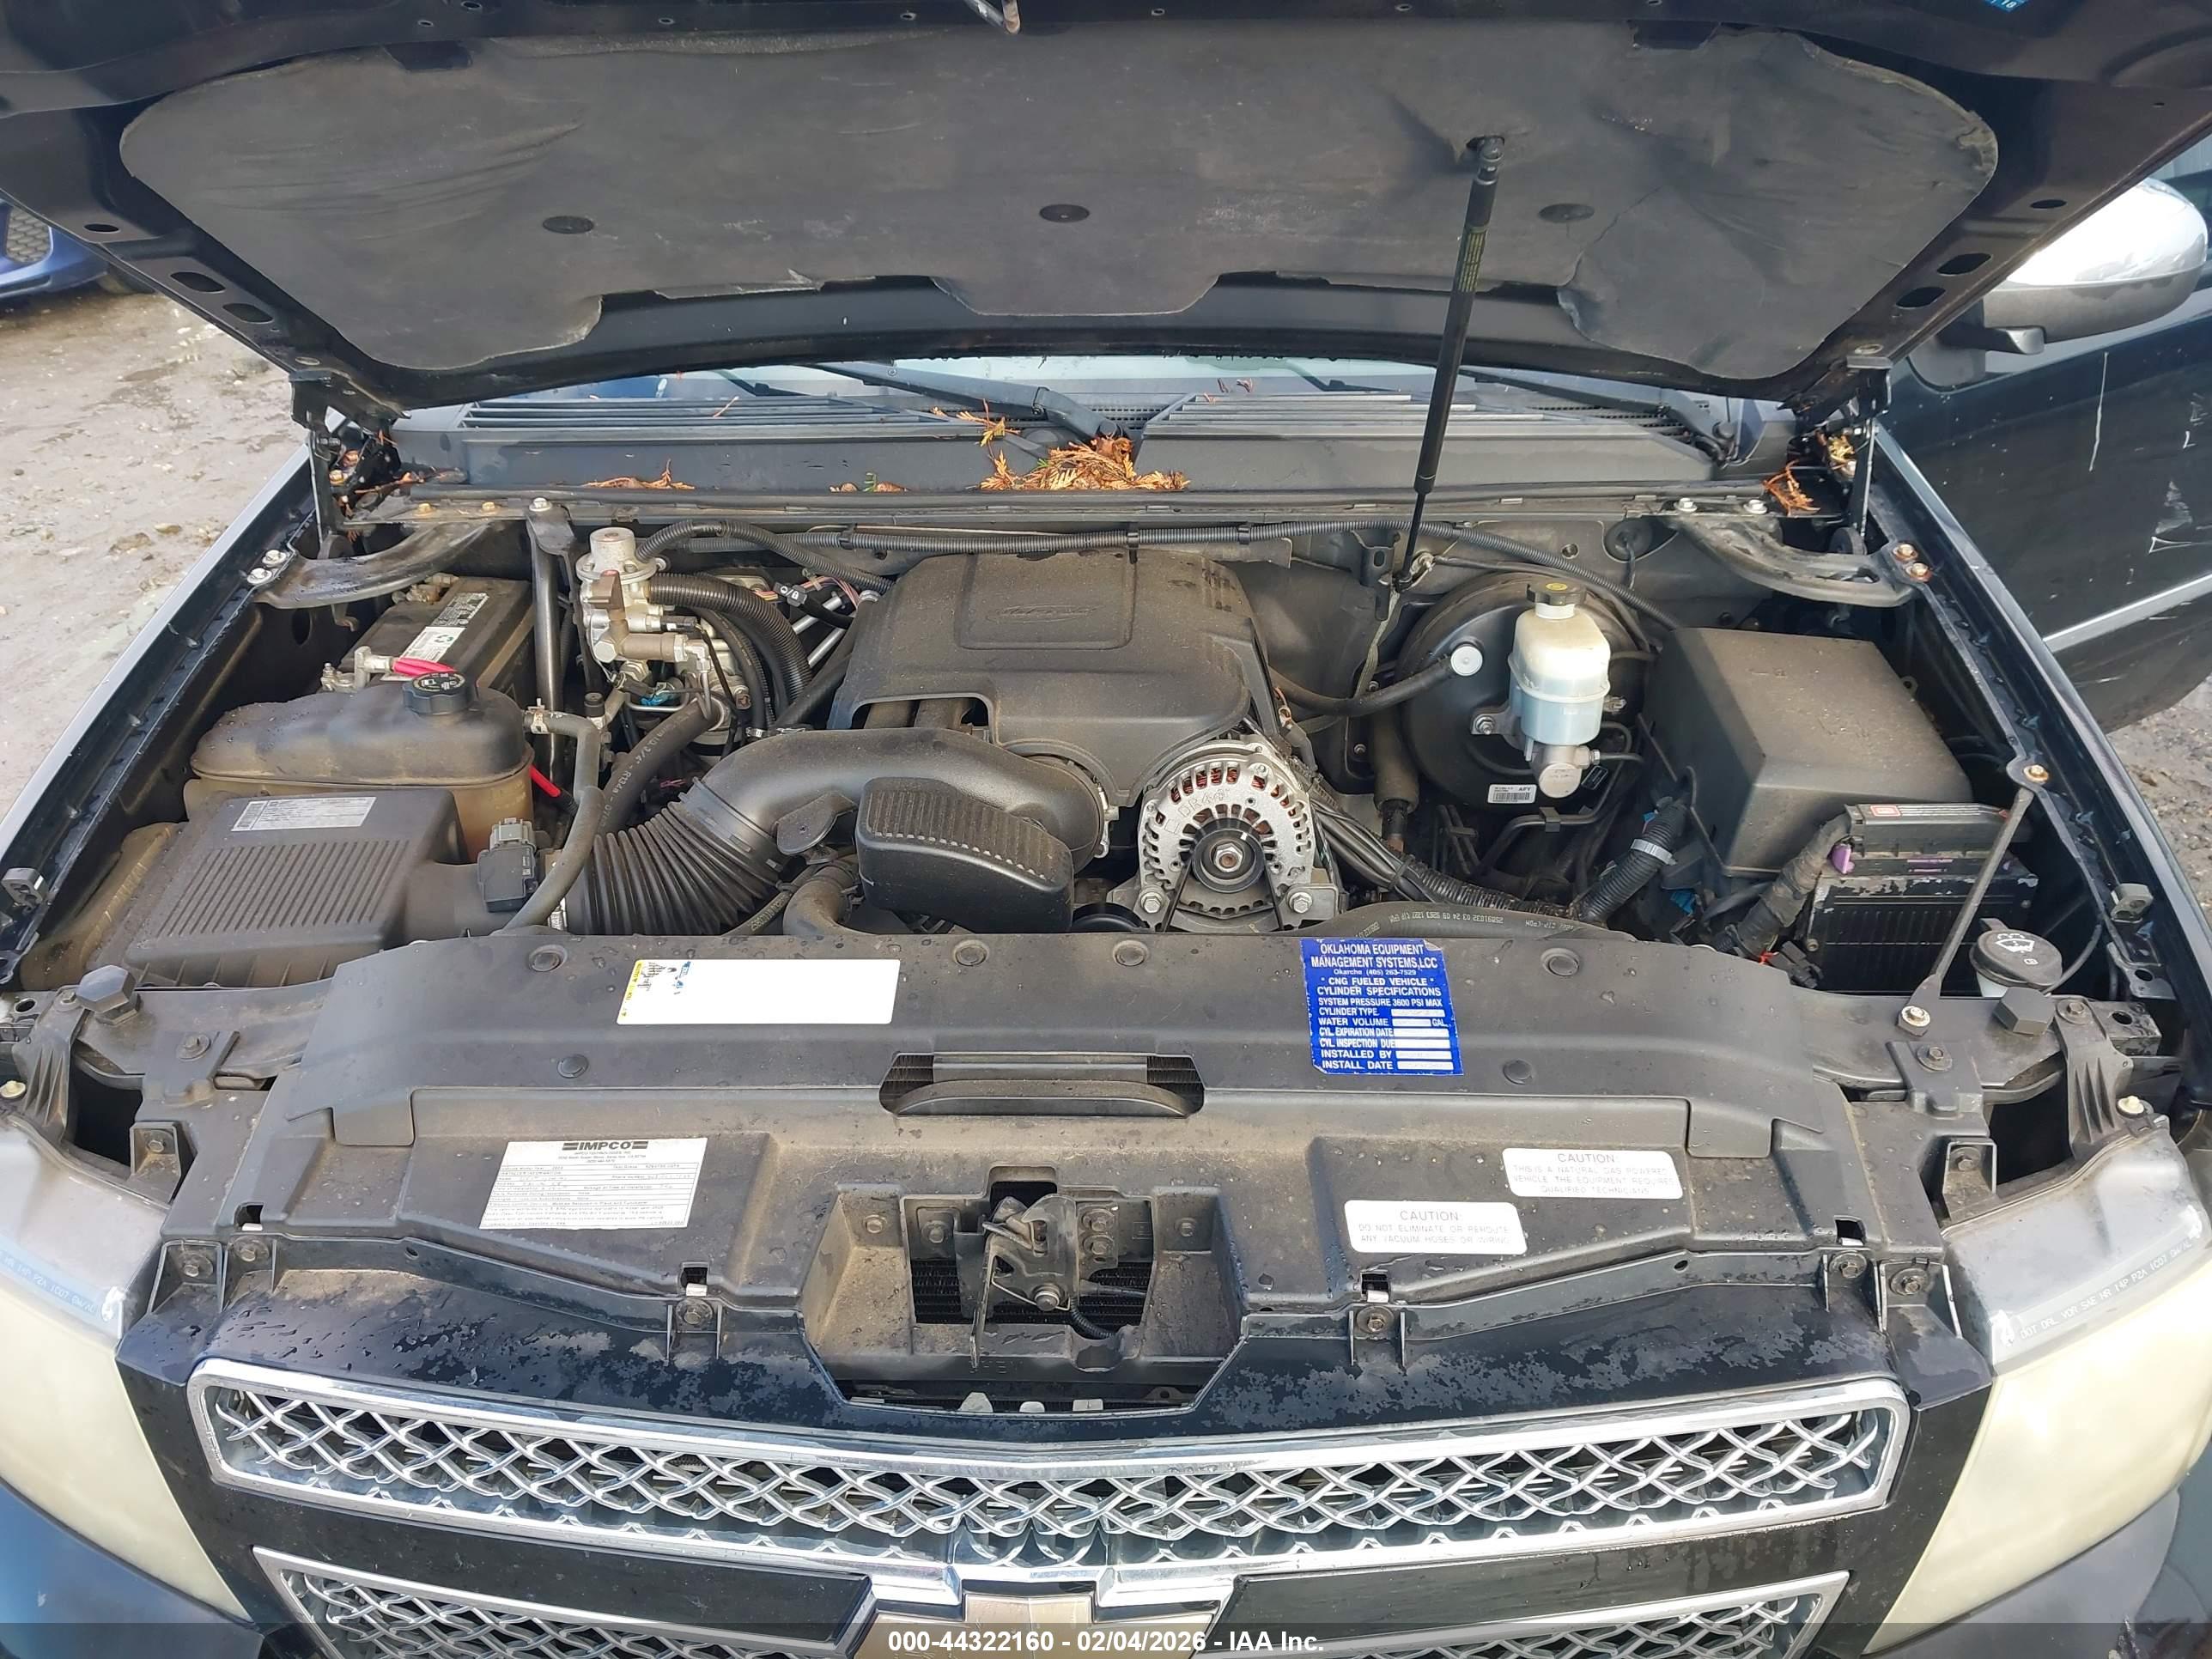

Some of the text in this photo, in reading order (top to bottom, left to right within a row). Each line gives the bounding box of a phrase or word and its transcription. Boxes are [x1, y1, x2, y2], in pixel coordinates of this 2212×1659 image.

[1320, 944, 1424, 954] OKLAHOMA EQUIPMENT
[1311, 957, 1373, 968] MANAGEMENT
[1317, 987, 1441, 996] CYLINDER SPECIFICATIONS
[579, 1141, 631, 1150] IMPCO
